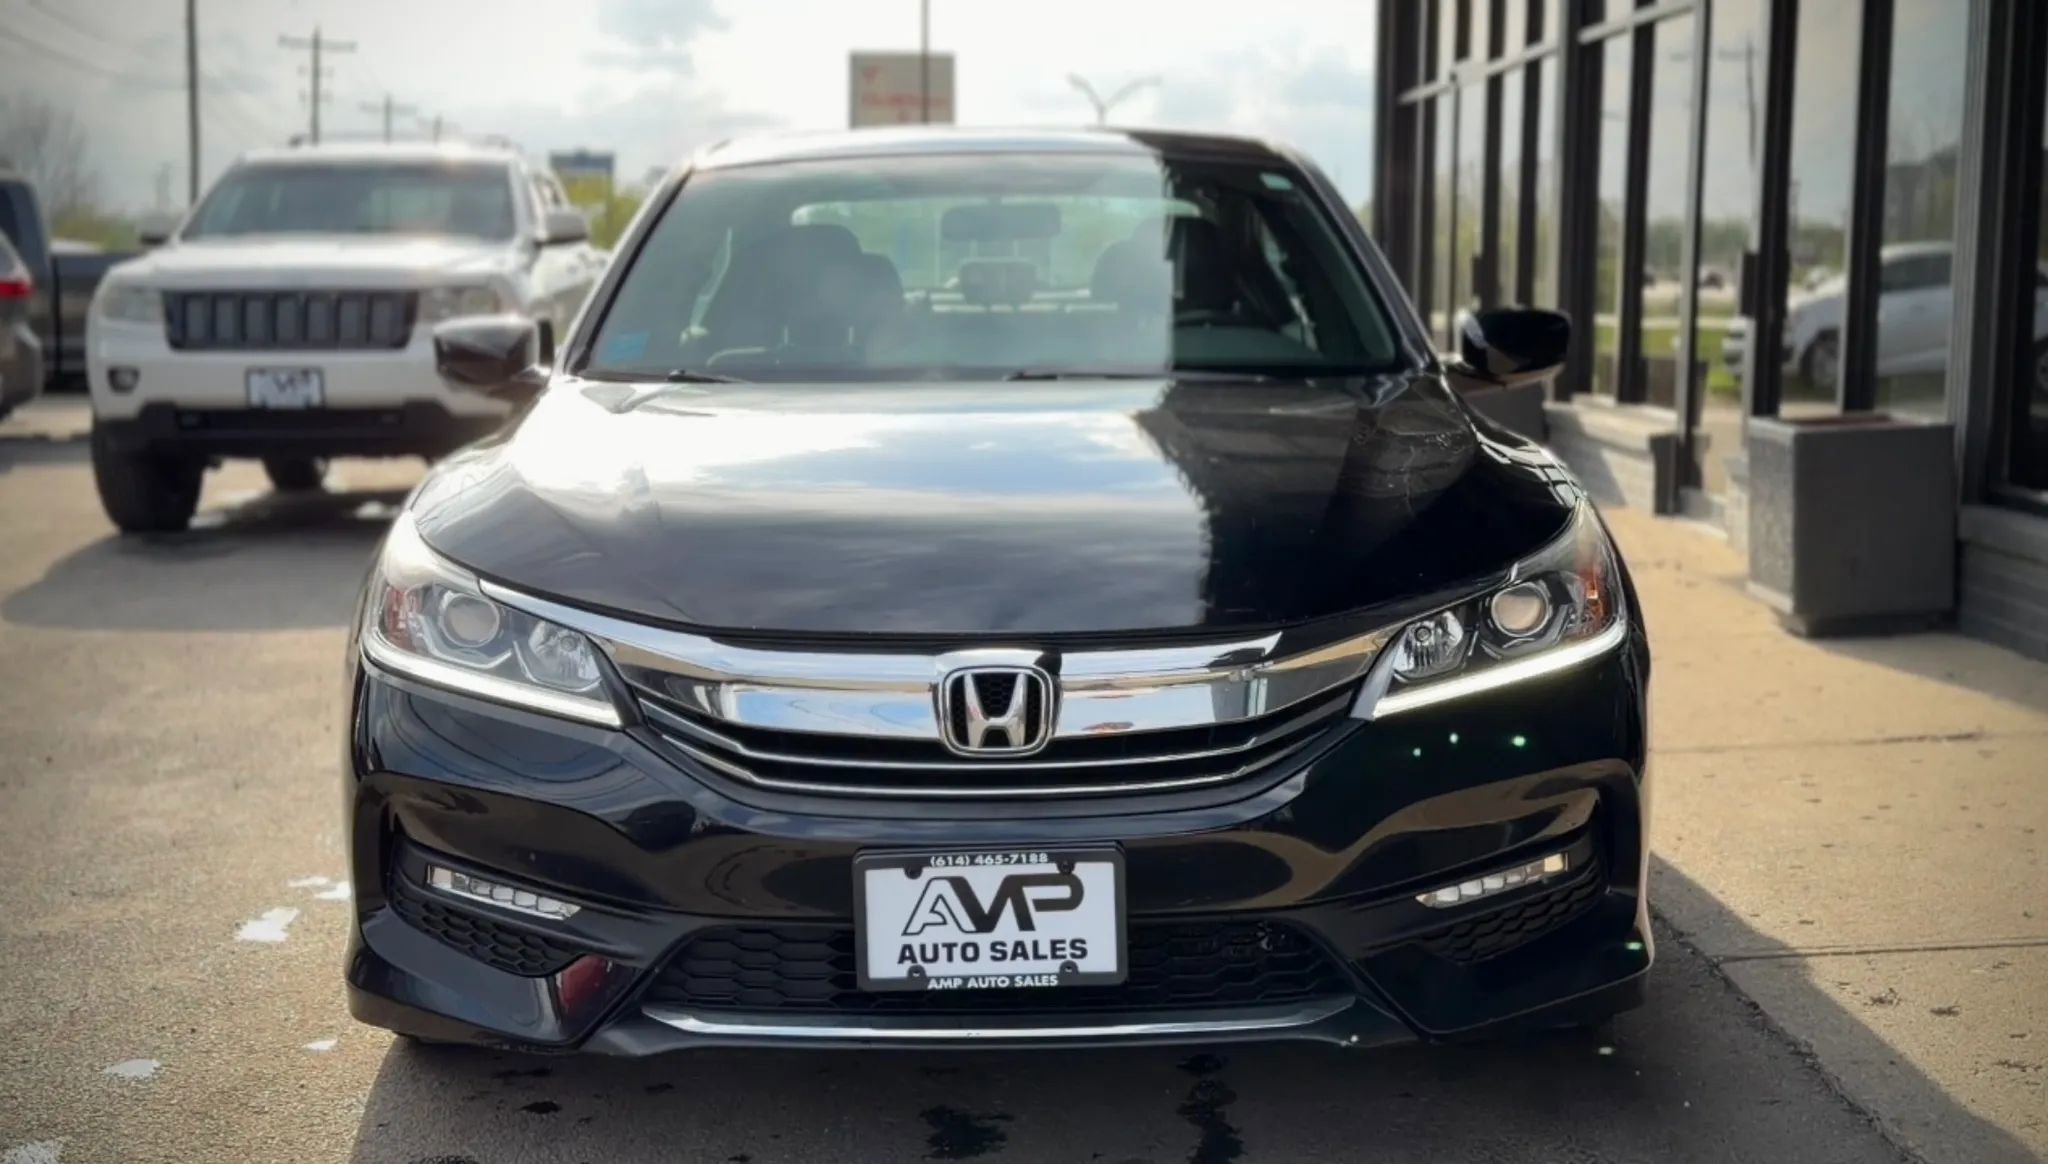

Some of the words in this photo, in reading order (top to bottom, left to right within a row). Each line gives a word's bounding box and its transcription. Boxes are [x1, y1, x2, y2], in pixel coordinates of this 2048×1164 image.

[930, 855, 971, 867] (614)
[974, 852, 1049, 865] 465-7188
[898, 942, 981, 965] AUTO
[990, 938, 1089, 962] SALES
[927, 977, 963, 990] AMP
[967, 976, 1010, 988] AUTO
[1014, 975, 1059, 988] SALES
